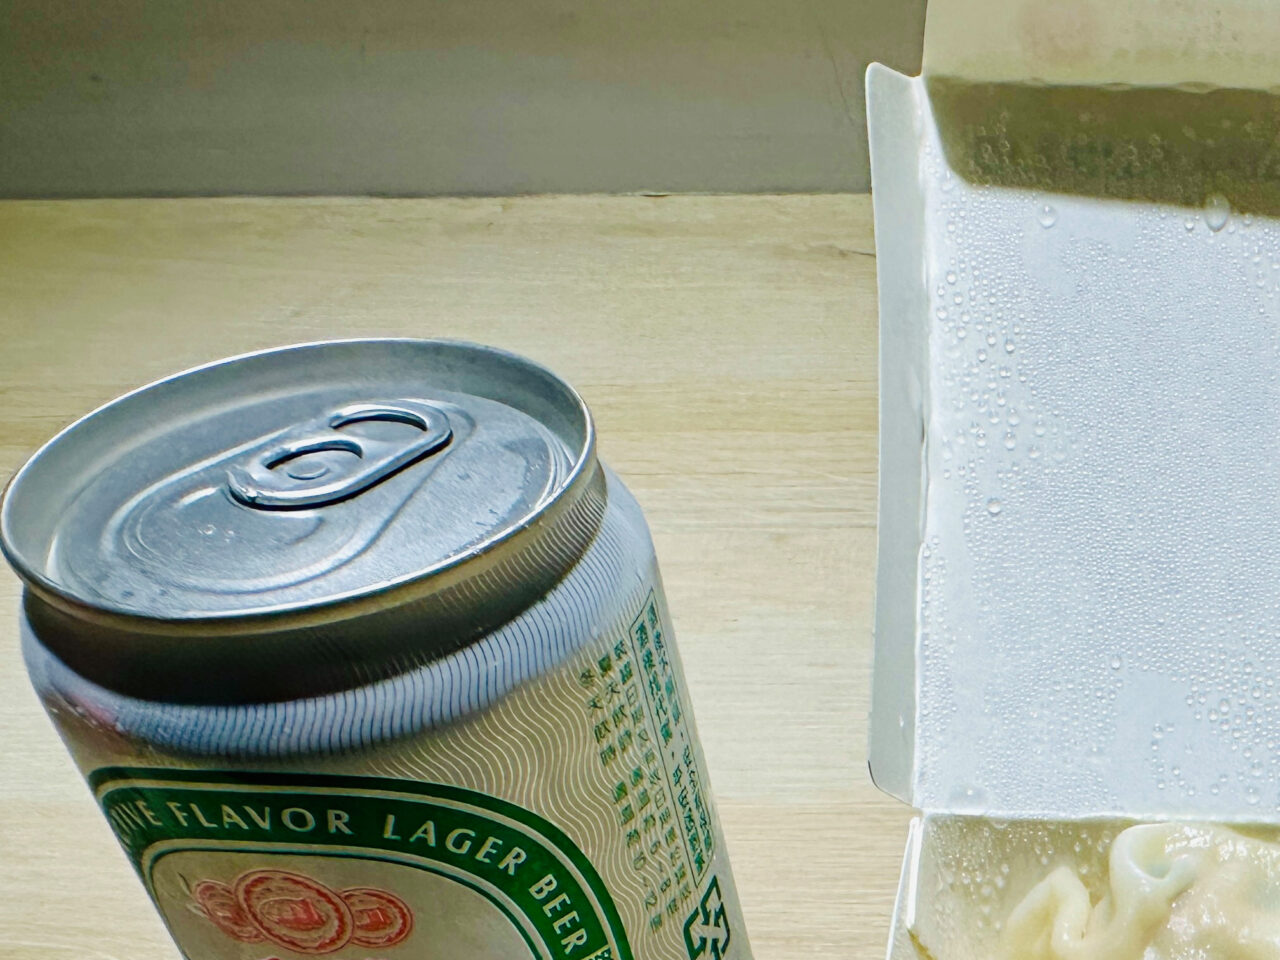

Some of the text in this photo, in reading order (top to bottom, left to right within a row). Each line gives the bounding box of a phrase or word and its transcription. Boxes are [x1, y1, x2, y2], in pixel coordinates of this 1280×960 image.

[166, 801, 353, 835] FLAVOR
[383, 814, 527, 876] LAGER
[528, 873, 588, 954] BEER
